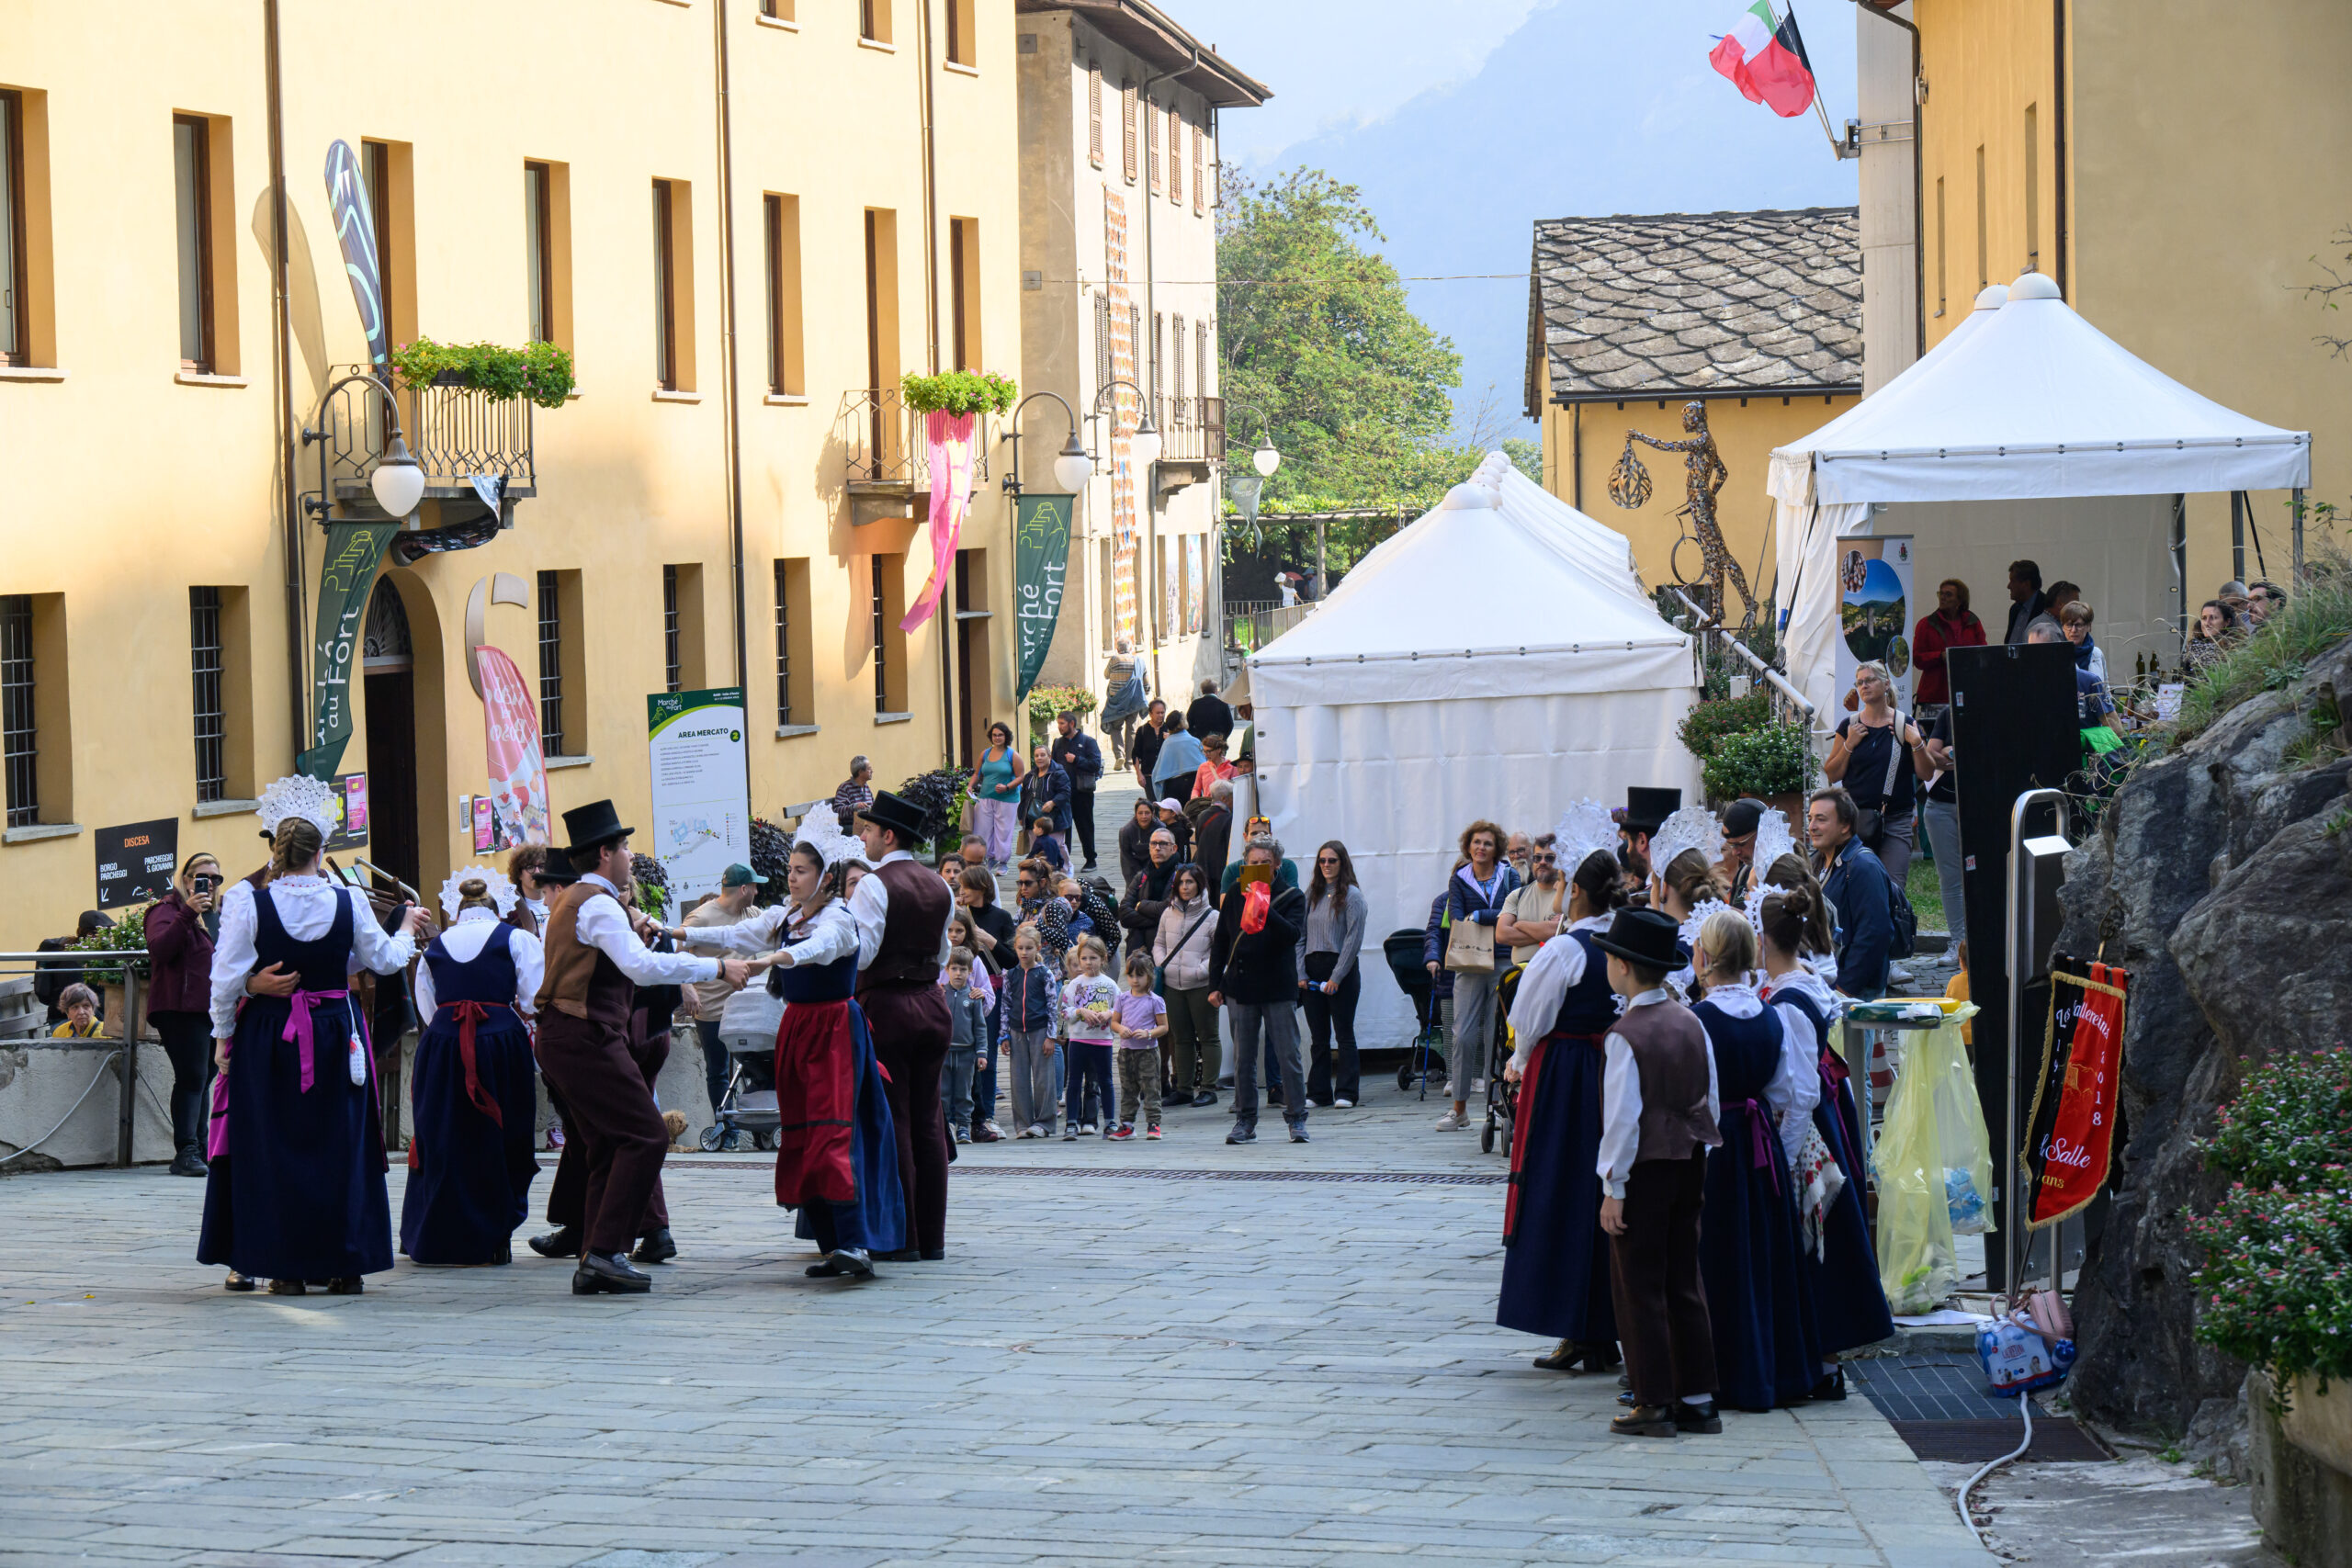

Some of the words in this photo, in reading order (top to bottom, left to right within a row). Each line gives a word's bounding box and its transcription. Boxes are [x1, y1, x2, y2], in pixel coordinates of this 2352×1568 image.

[1038, 561, 1066, 619] Fort
[328, 606, 359, 684] Fort
[657, 696, 679, 706] Marché
[329, 694, 339, 728] au
[696, 728, 729, 737] MERCATO
[732, 731, 739, 740] 2
[124, 834, 150, 848] DISCESA
[143, 852, 174, 865] PARCHEGGIO
[99, 862, 118, 873] BORGO
[147, 864, 152, 874] S.
[151, 861, 174, 873] GIOVANNI
[100, 869, 128, 881] PARCHEGGI
[2045, 1137, 2091, 1168] Salle
[2041, 1175, 2064, 1189] ans
